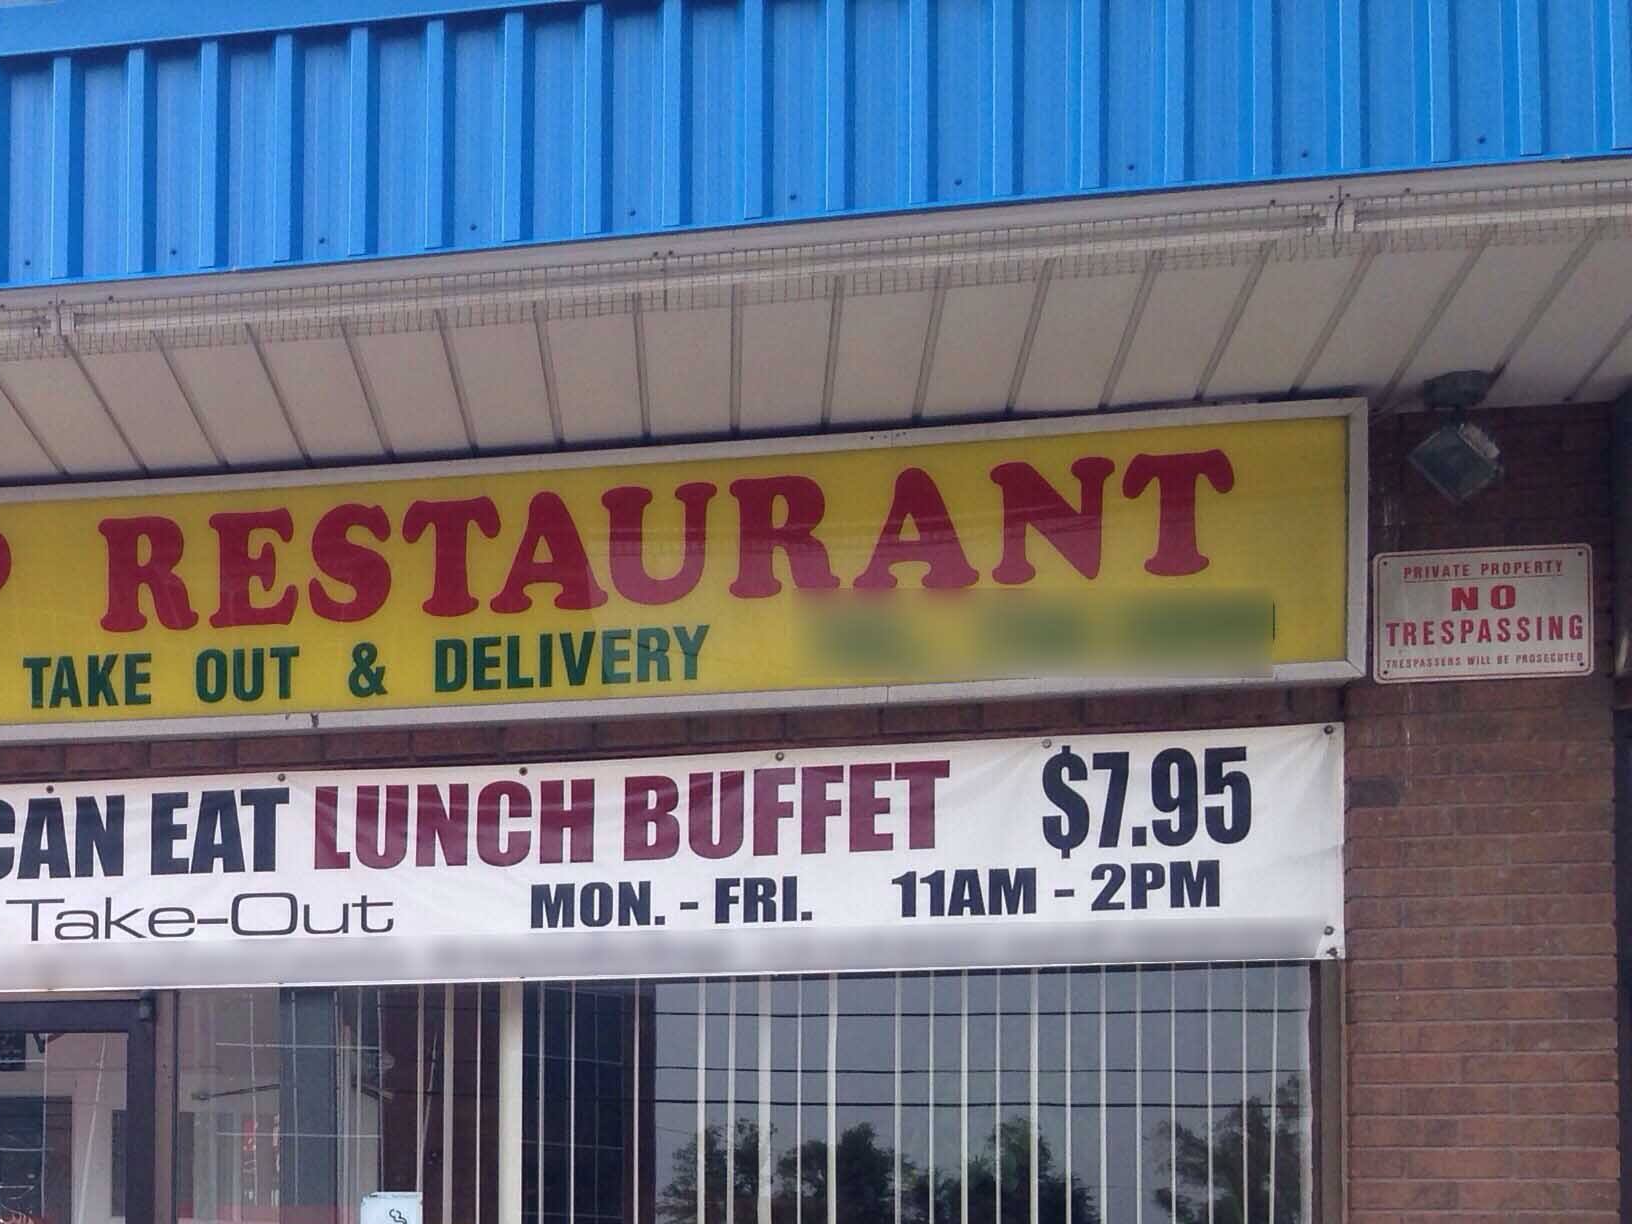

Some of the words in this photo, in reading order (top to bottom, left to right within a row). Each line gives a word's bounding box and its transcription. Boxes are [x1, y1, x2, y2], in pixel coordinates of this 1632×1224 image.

[97, 448, 1235, 633] RESTAURANT
[1403, 564, 1470, 580] PRIVATE
[1480, 560, 1564, 576] PROPERTY
[1451, 584, 1516, 612] NO
[1385, 656, 1462, 669] TRESPASSERS
[1467, 655, 1490, 666] WILL
[1496, 654, 1509, 665] BE
[1515, 651, 1584, 664] PROSECUTED
[1386, 614, 1584, 647] TRESPASSING
[23, 652, 152, 710] TAKE
[194, 646, 300, 704] OUT
[347, 642, 388, 698] &
[433, 624, 711, 694] DELIVERY
[150, 786, 291, 875] EAT
[312, 776, 597, 871] LUNCH
[623, 758, 951, 862] BUFFET
[1041, 744, 1253, 861] $7.95
[5, 891, 395, 943] Take-Out
[530, 881, 666, 930] MON.
[714, 876, 812, 925] FRI.
[891, 868, 1037, 919] 11AM
[1091, 859, 1222, 914] 2PM
